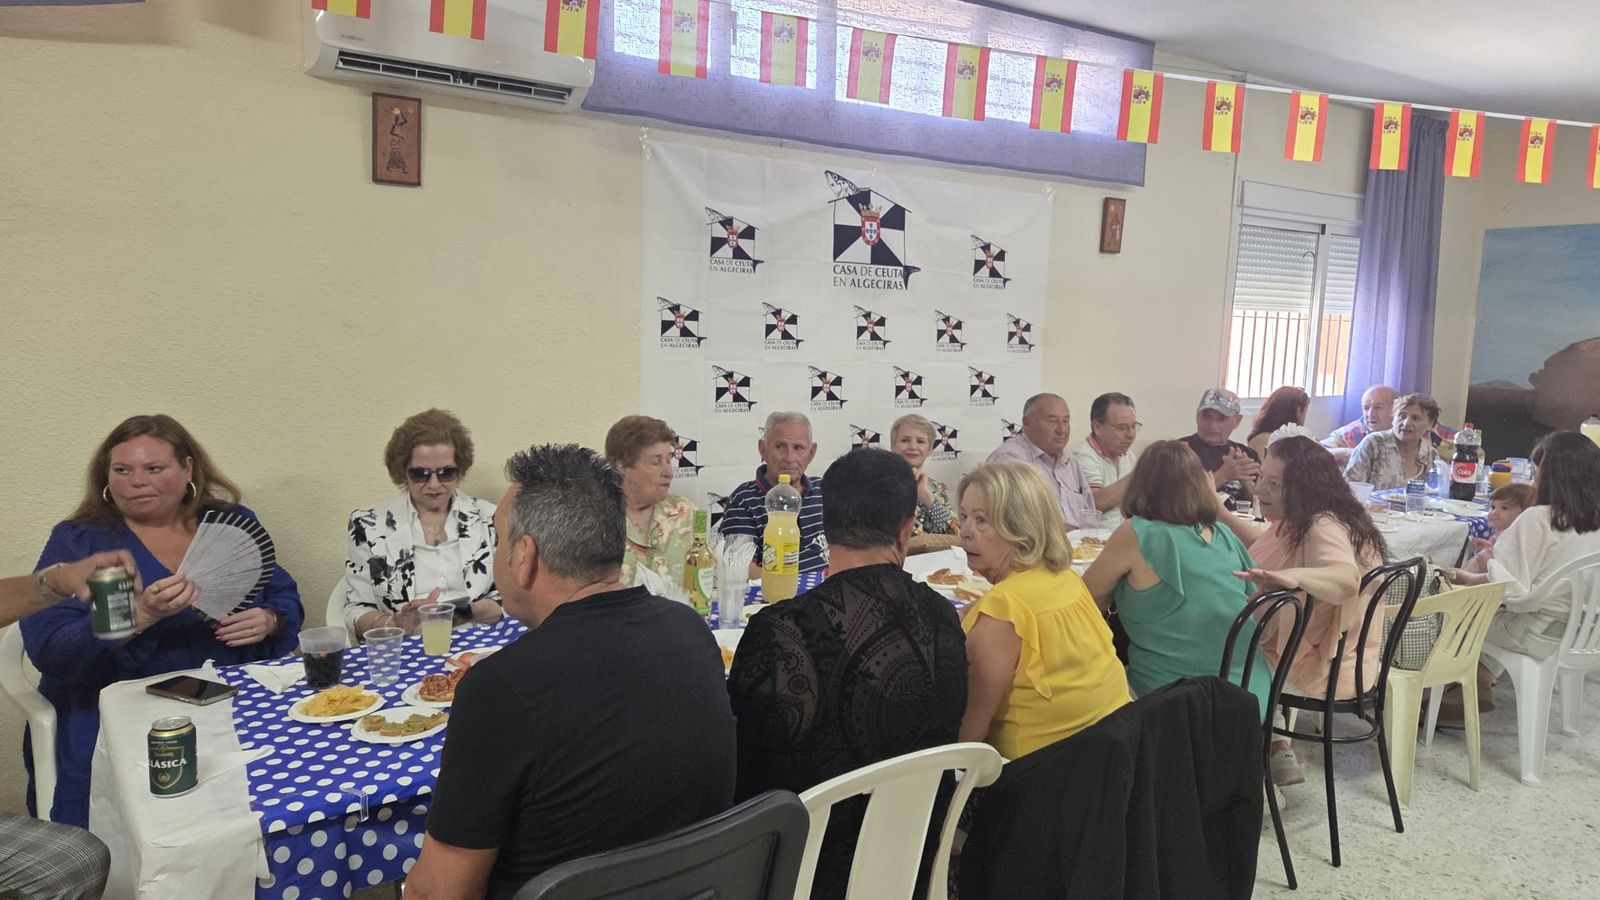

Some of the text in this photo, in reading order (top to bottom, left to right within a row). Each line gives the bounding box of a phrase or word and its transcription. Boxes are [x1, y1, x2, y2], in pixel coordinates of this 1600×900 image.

[720, 266, 753, 274] ALGECIRAS
[833, 264, 904, 279] CASA DE CEUTA
[833, 277, 903, 291] EN ALGECIRAS
[148, 758, 187, 768] LÁSICA
